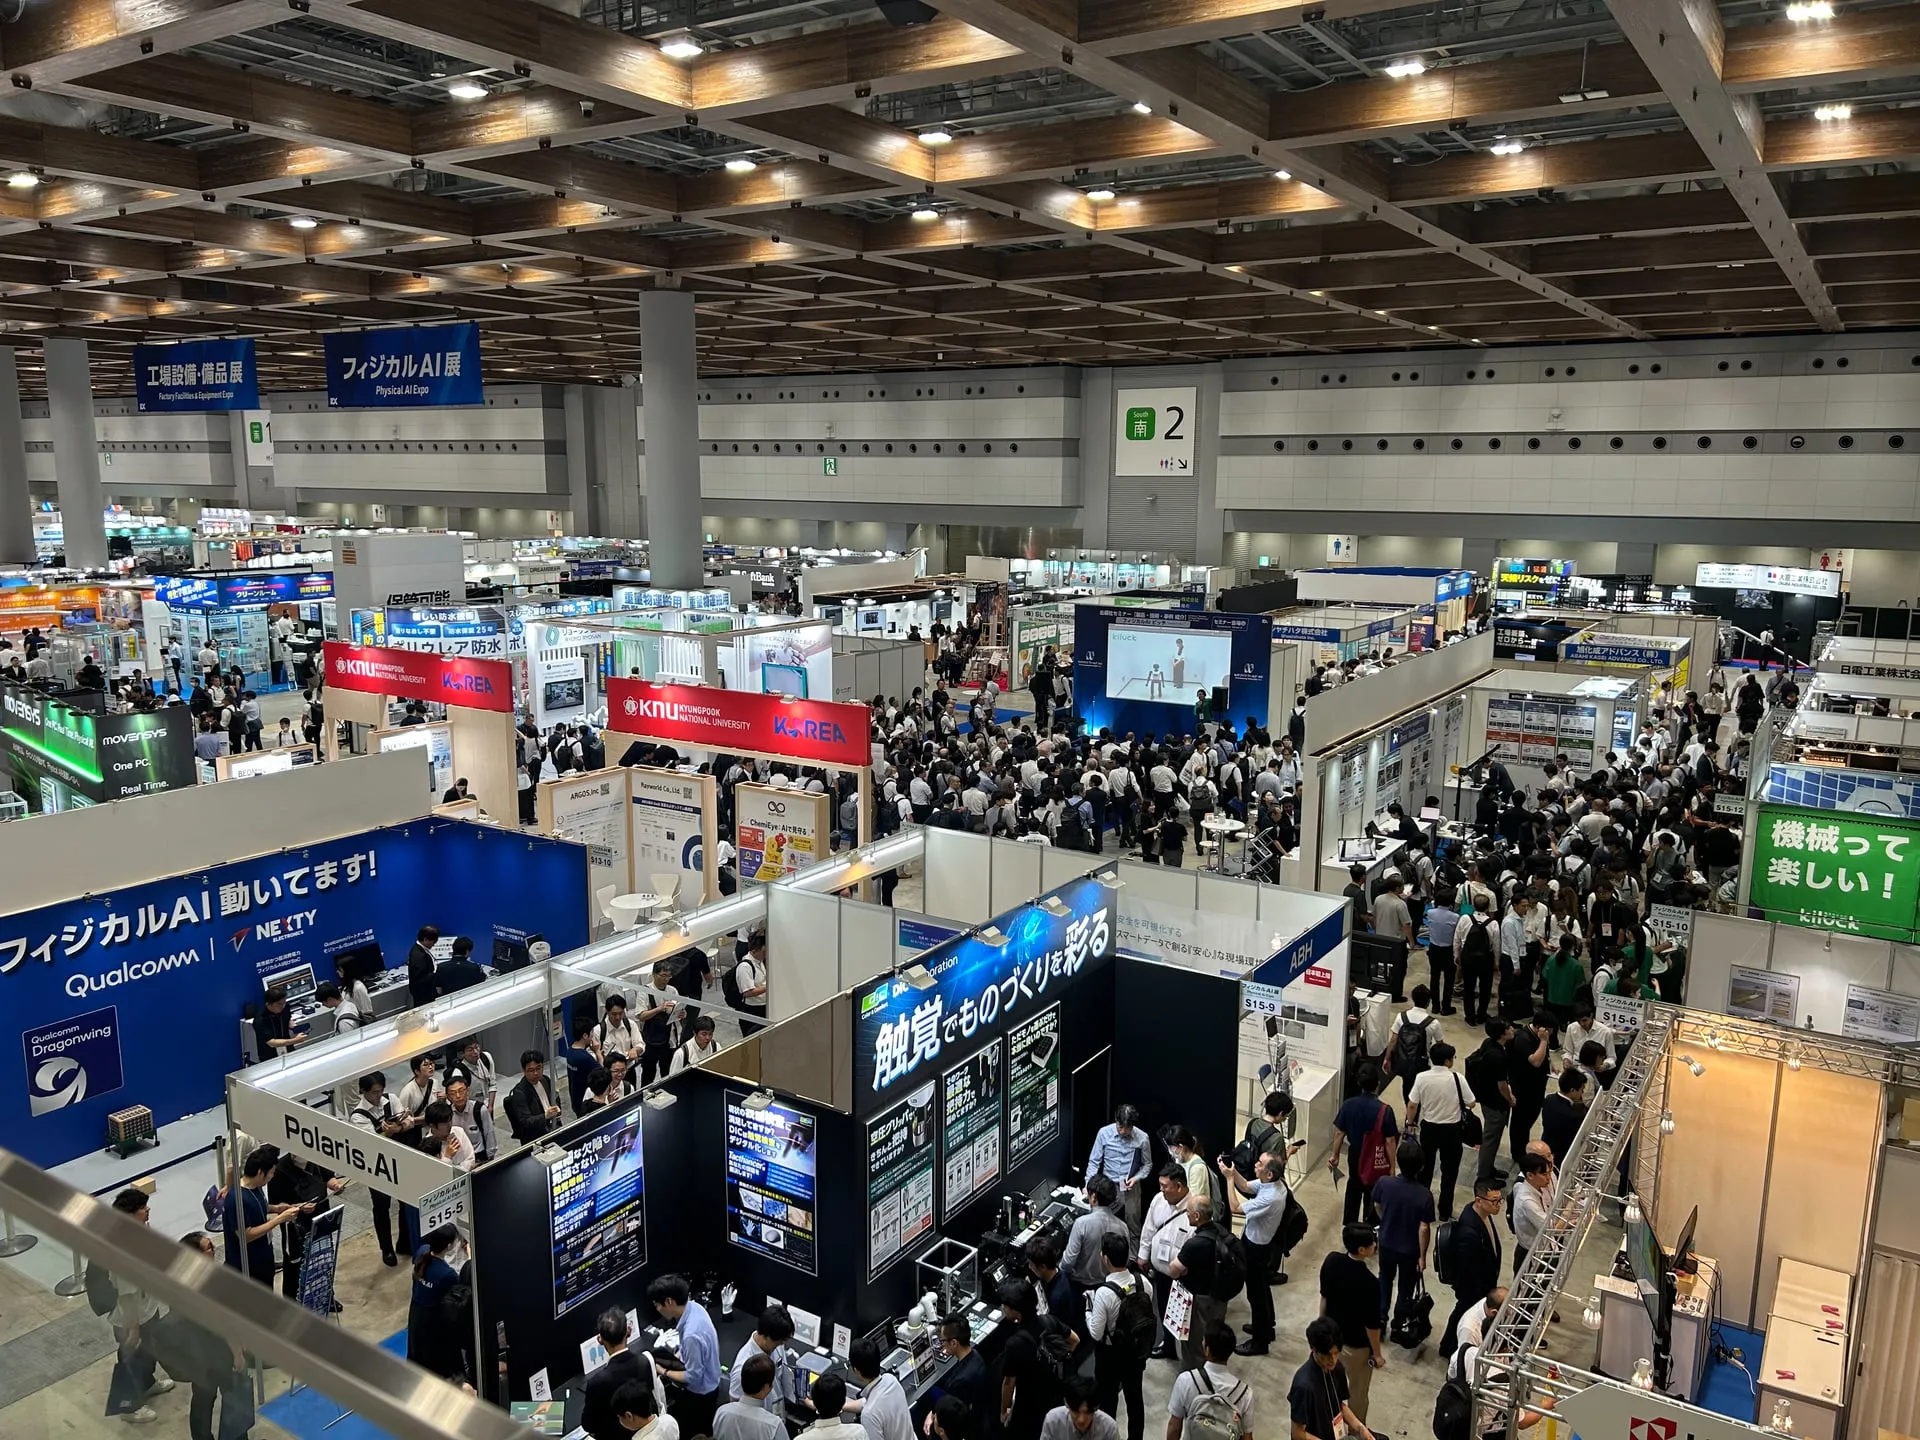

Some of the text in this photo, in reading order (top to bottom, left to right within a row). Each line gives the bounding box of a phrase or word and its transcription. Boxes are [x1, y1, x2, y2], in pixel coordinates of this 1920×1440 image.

[147, 361, 243, 386] 工場設備・備品展
[342, 352, 461, 380] フィジカルAI展
[375, 384, 429, 398] Physical AI Expo
[266, 422, 272, 443] 1
[1134, 418, 1148, 437] 南
[1164, 406, 1184, 440] 2
[375, 672, 426, 685] NATIONAL UNIVERSITY
[679, 705, 721, 717] KYUNGPOOK
[679, 714, 751, 731] NATIONAL UNIVERSITY
[113, 758, 152, 772] One PC.
[121, 780, 169, 795] Real Time.
[641, 782, 662, 792] Rayworld
[1771, 820, 1910, 862] 機械って
[256, 909, 318, 940] NEXTY
[1653, 918, 1688, 931] S15-10
[1289, 939, 1313, 973] ABH
[65, 948, 200, 998] Qualcomm
[872, 907, 1110, 1092] 触覚でものづくりを彩る
[1245, 998, 1275, 1012] S15-9
[1603, 1011, 1637, 1026] S15-6
[31, 1024, 79, 1046] Qualcomm
[33, 1024, 112, 1058] Dragonwing
[285, 1114, 400, 1186] Polaris.AI
[429, 1201, 463, 1228] S15-5
